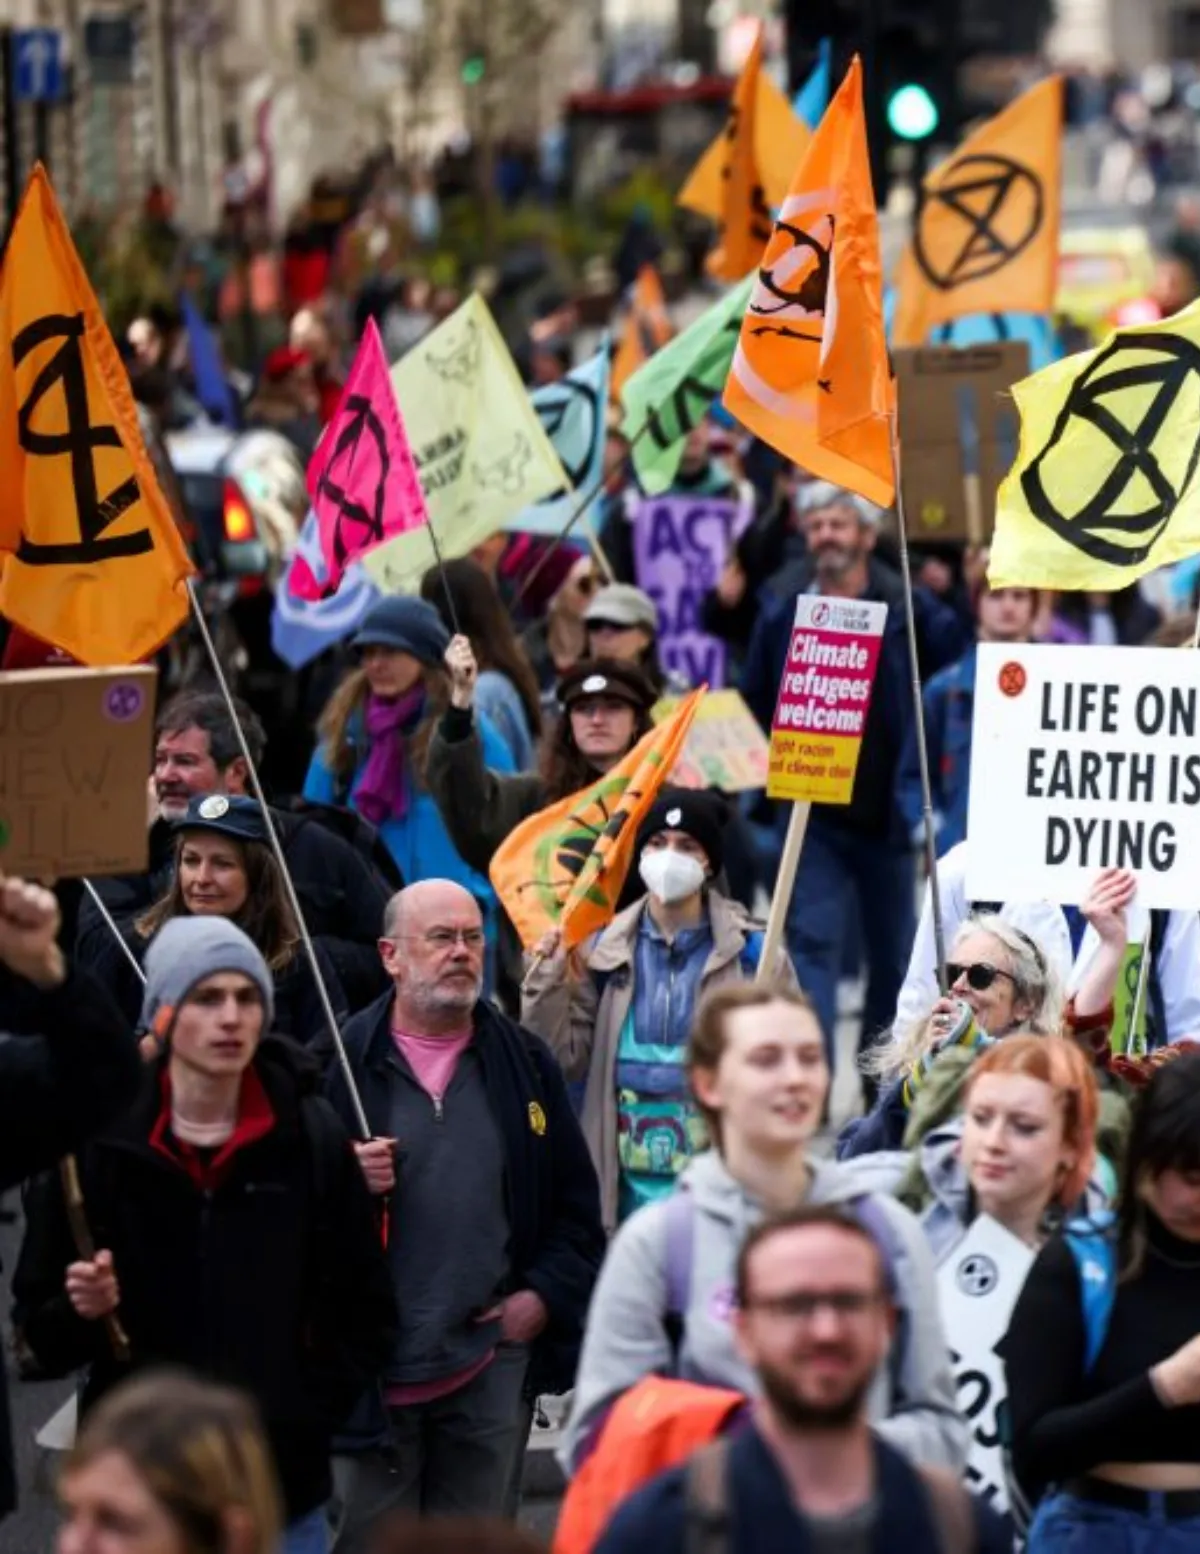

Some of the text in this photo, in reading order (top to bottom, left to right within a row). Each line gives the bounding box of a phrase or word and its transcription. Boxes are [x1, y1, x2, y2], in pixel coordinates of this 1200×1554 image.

[649, 507, 734, 559] ACT
[791, 633, 869, 670] Climate
[783, 667, 871, 706] refugees
[1041, 681, 1196, 736] LIFE ON
[778, 698, 864, 732] welcome
[0, 746, 114, 799] EW
[1026, 747, 1154, 803] EARTH
[0, 800, 97, 858] IL
[1045, 816, 1176, 872] DYING
